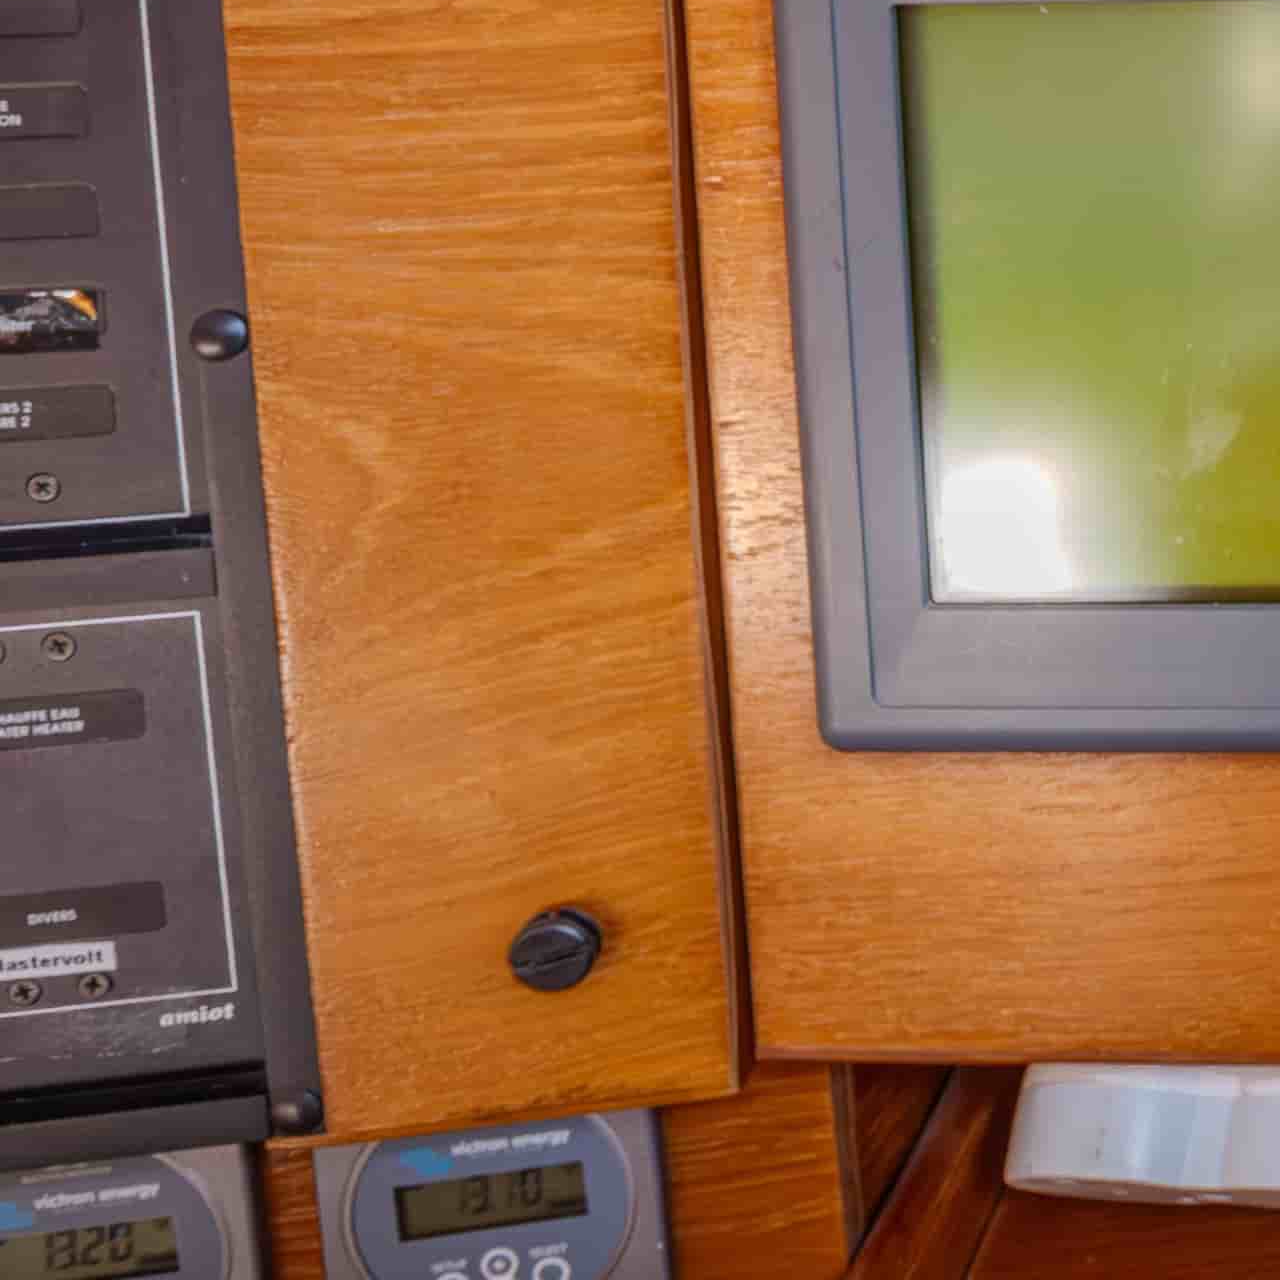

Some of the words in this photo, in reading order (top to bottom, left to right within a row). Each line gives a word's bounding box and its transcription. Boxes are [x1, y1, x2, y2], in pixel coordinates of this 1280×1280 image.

[451, 1136, 509, 1157] victron
[510, 1127, 571, 1148] energy
[33, 1191, 97, 1211] victron
[97, 1183, 162, 1202] energy
